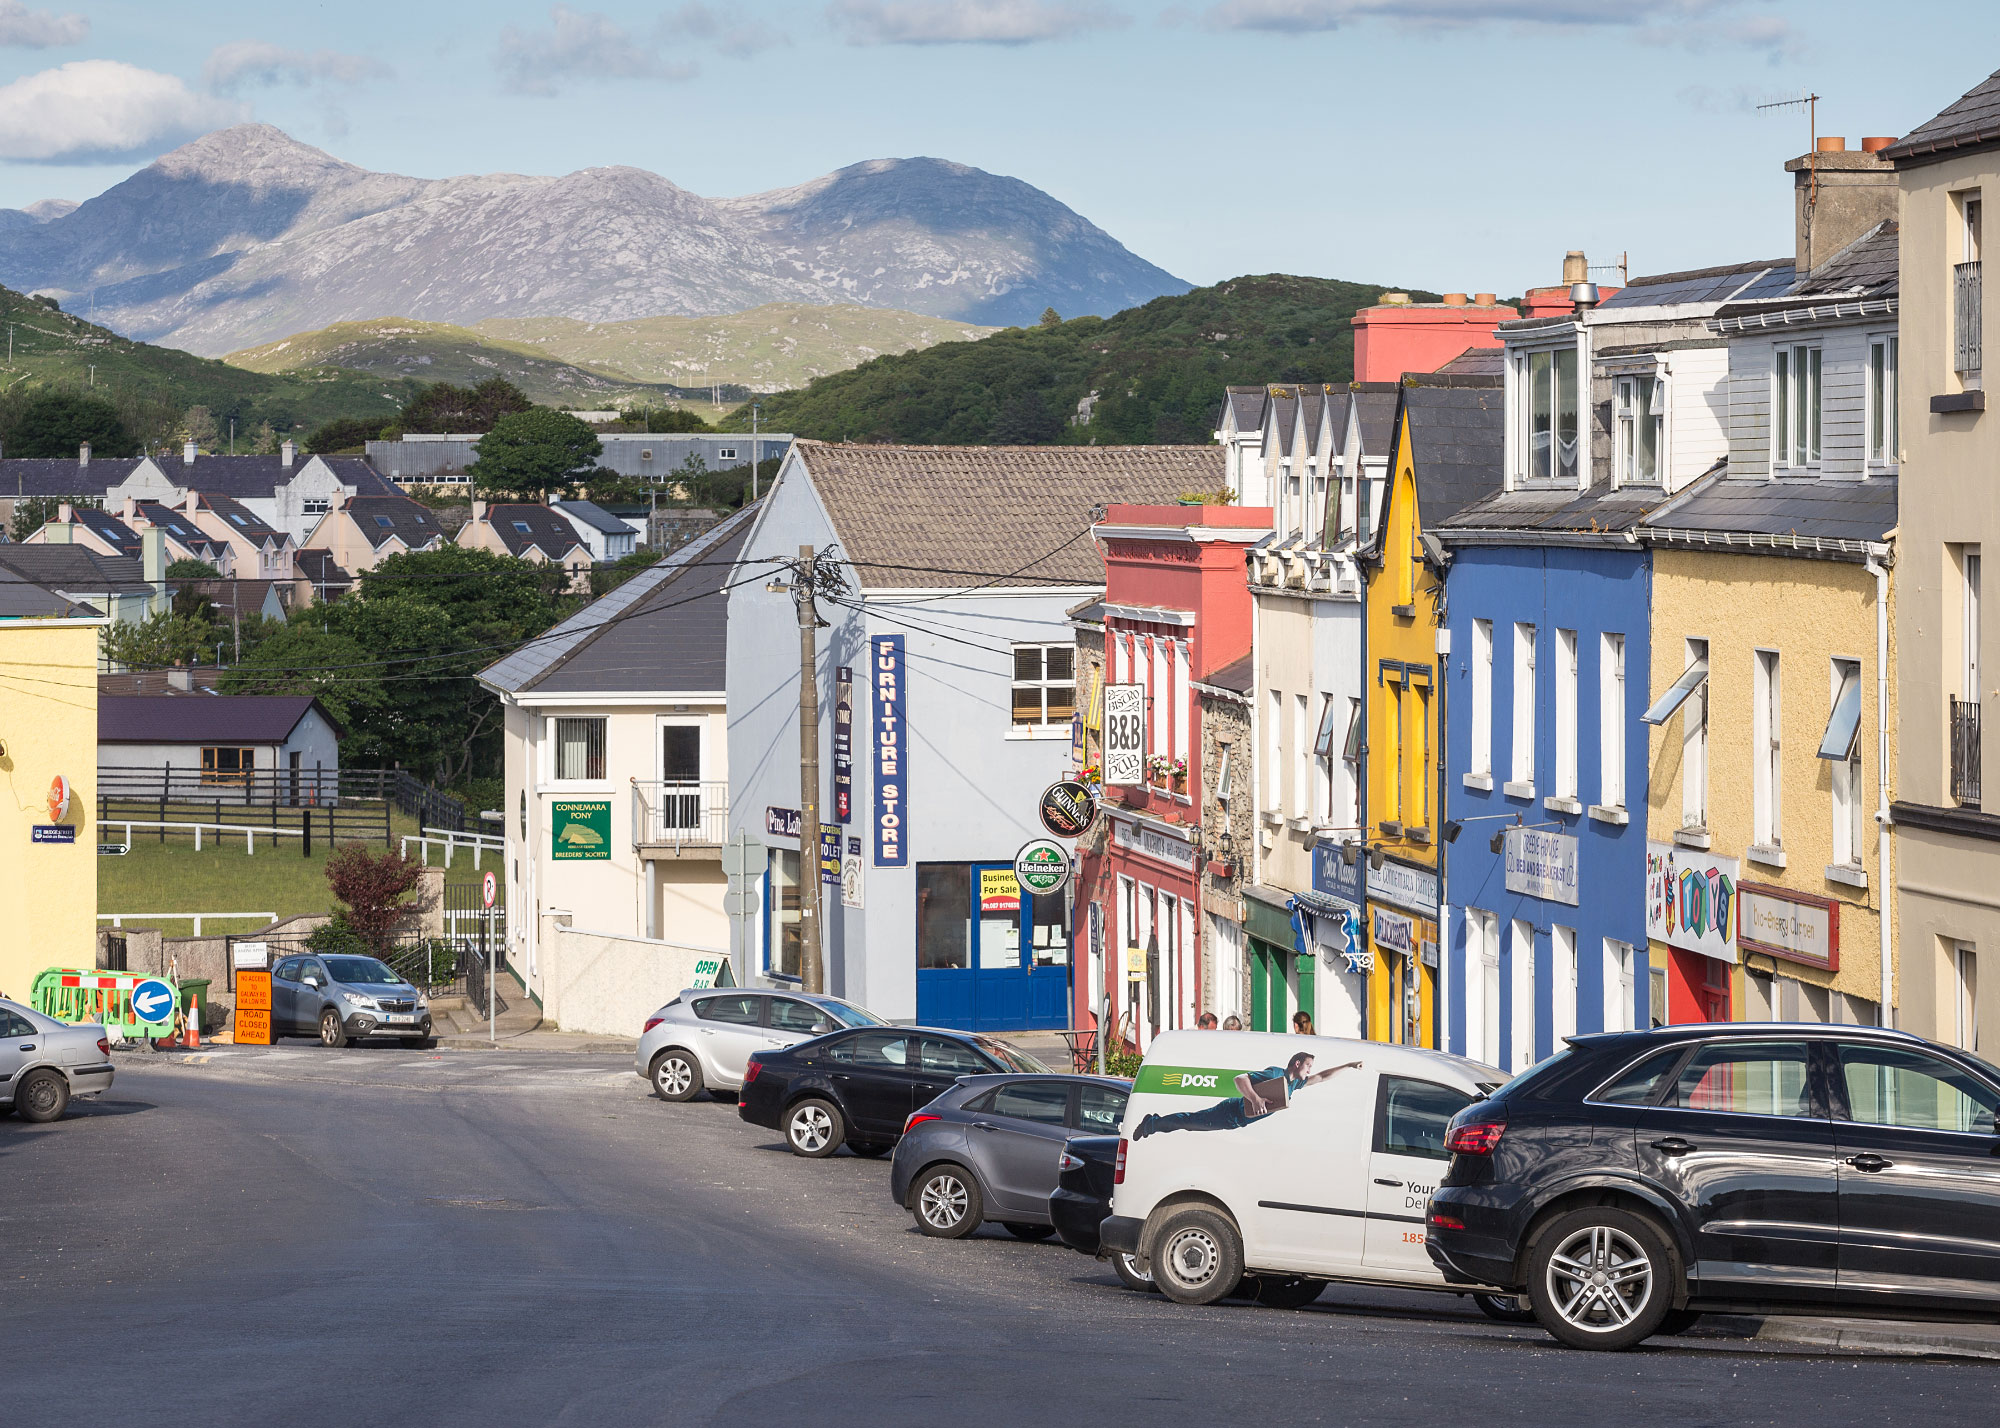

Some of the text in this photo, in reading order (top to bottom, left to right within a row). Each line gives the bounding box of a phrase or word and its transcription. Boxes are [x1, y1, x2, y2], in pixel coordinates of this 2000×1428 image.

[1108, 689, 1140, 712] BISTRO
[1108, 714, 1141, 751] B&B
[878, 641, 900, 859] FURNITURE STORE
[1108, 754, 1140, 779] PUB
[555, 803, 607, 811] CONNEMARA
[1052, 786, 1089, 828] GUINNESS
[570, 812, 592, 820] PONY
[768, 809, 785, 832] Pine
[820, 844, 828, 856] TO
[829, 845, 841, 858] LET
[1020, 862, 1065, 873] Heineken
[1516, 858, 1566, 883] BED AND BREAKFAST
[984, 886, 998, 894] For
[1000, 886, 1017, 894] Sale
[695, 959, 720, 975] OPEN
[248, 975, 267, 983] ACCESS
[243, 1010, 264, 1019] ROAD
[239, 1020, 268, 1029] CLOSED
[240, 1030, 265, 1039] AHEAD
[1406, 1181, 1436, 1195] Your
[1405, 1196, 1426, 1210] Del
[1402, 1232, 1426, 1244] 185
